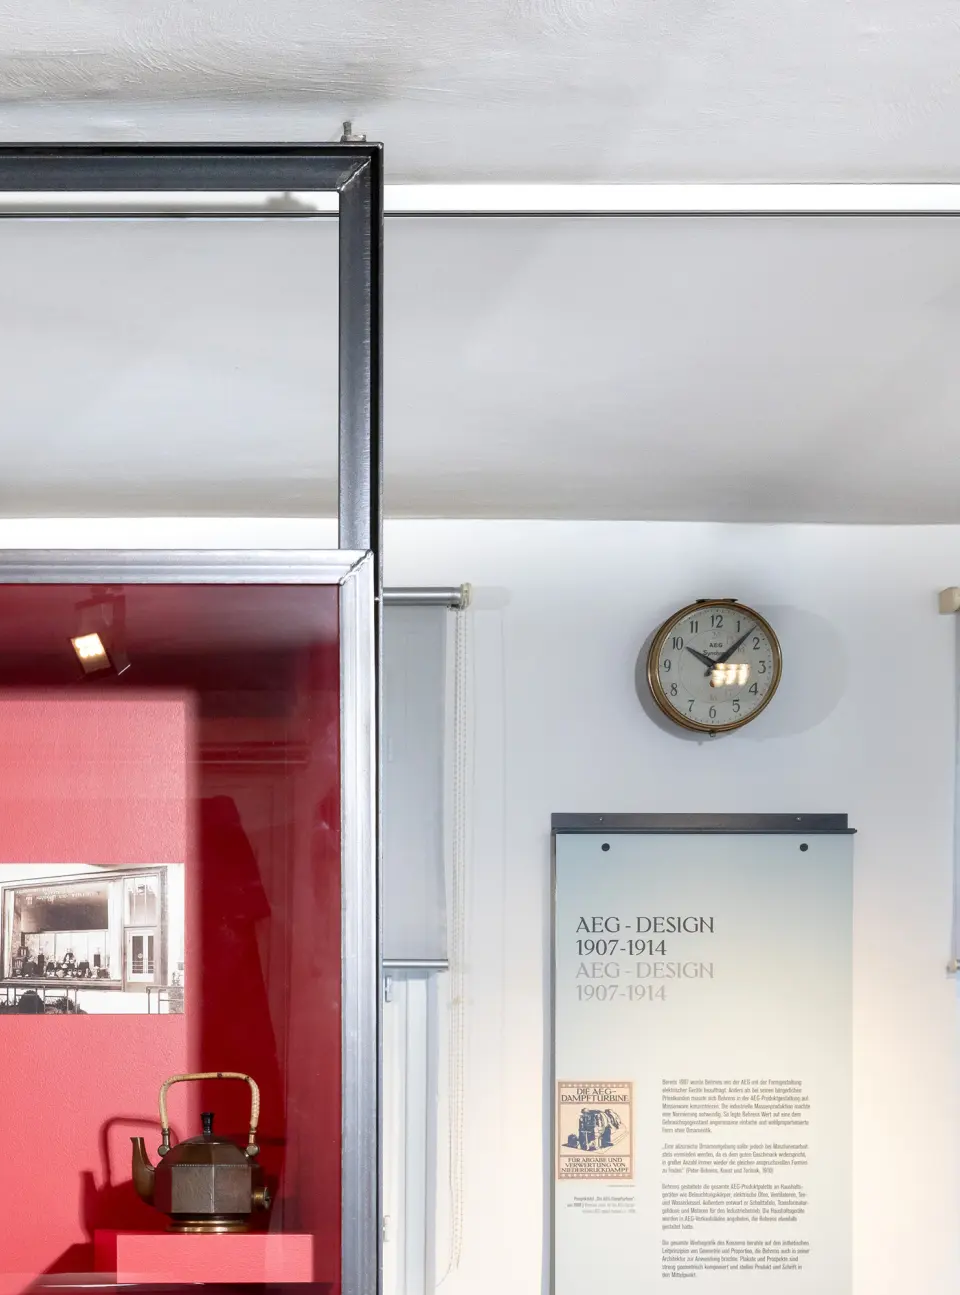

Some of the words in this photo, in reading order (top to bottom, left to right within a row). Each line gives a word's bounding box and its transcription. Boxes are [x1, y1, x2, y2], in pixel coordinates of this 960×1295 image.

[690, 621, 698, 633] 11
[711, 615, 723, 628] 12
[736, 620, 740, 632] 1
[672, 637, 684, 650] 10
[753, 637, 760, 650] 2
[664, 659, 671, 672] 9
[758, 660, 766, 674] 3
[670, 683, 678, 696] 8
[749, 682, 758, 695] 4
[688, 700, 695, 712] 7
[709, 705, 716, 718] 6
[733, 699, 740, 712] 5
[576, 917, 620, 933] AEG
[636, 917, 714, 933] DESIGN
[576, 939, 667, 956] 1907-1914
[576, 984, 667, 1001] 1907-1914
